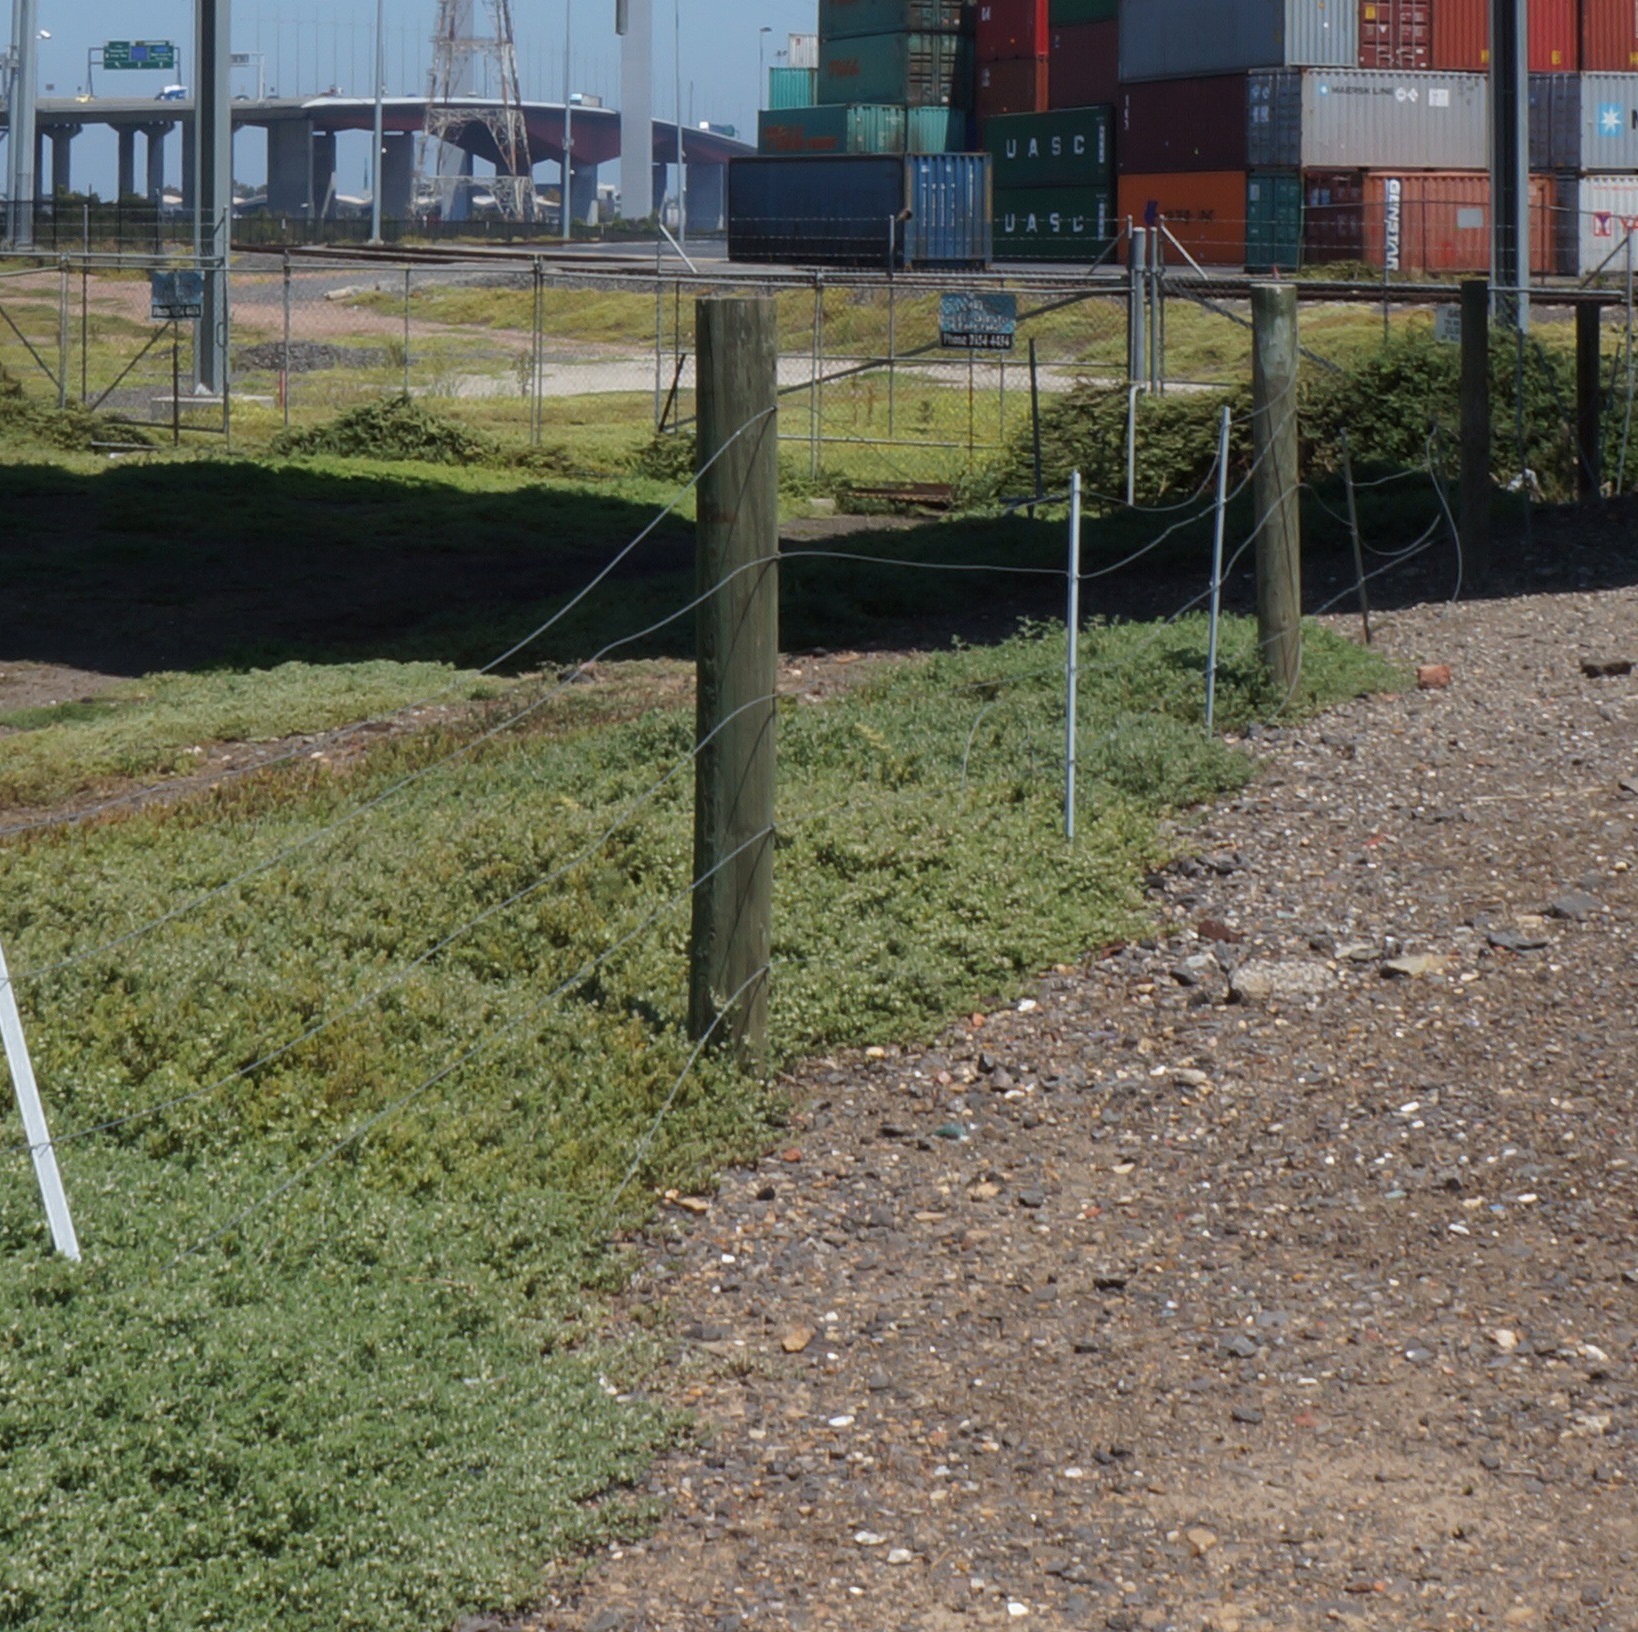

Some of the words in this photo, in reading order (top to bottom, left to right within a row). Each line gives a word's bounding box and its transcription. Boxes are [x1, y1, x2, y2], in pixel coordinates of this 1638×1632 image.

[1331, 86, 1370, 95] MAERSK
[1005, 134, 1085, 159] UASC
[1004, 212, 1084, 233] UASC
[1385, 179, 1400, 271] GENSTAR
